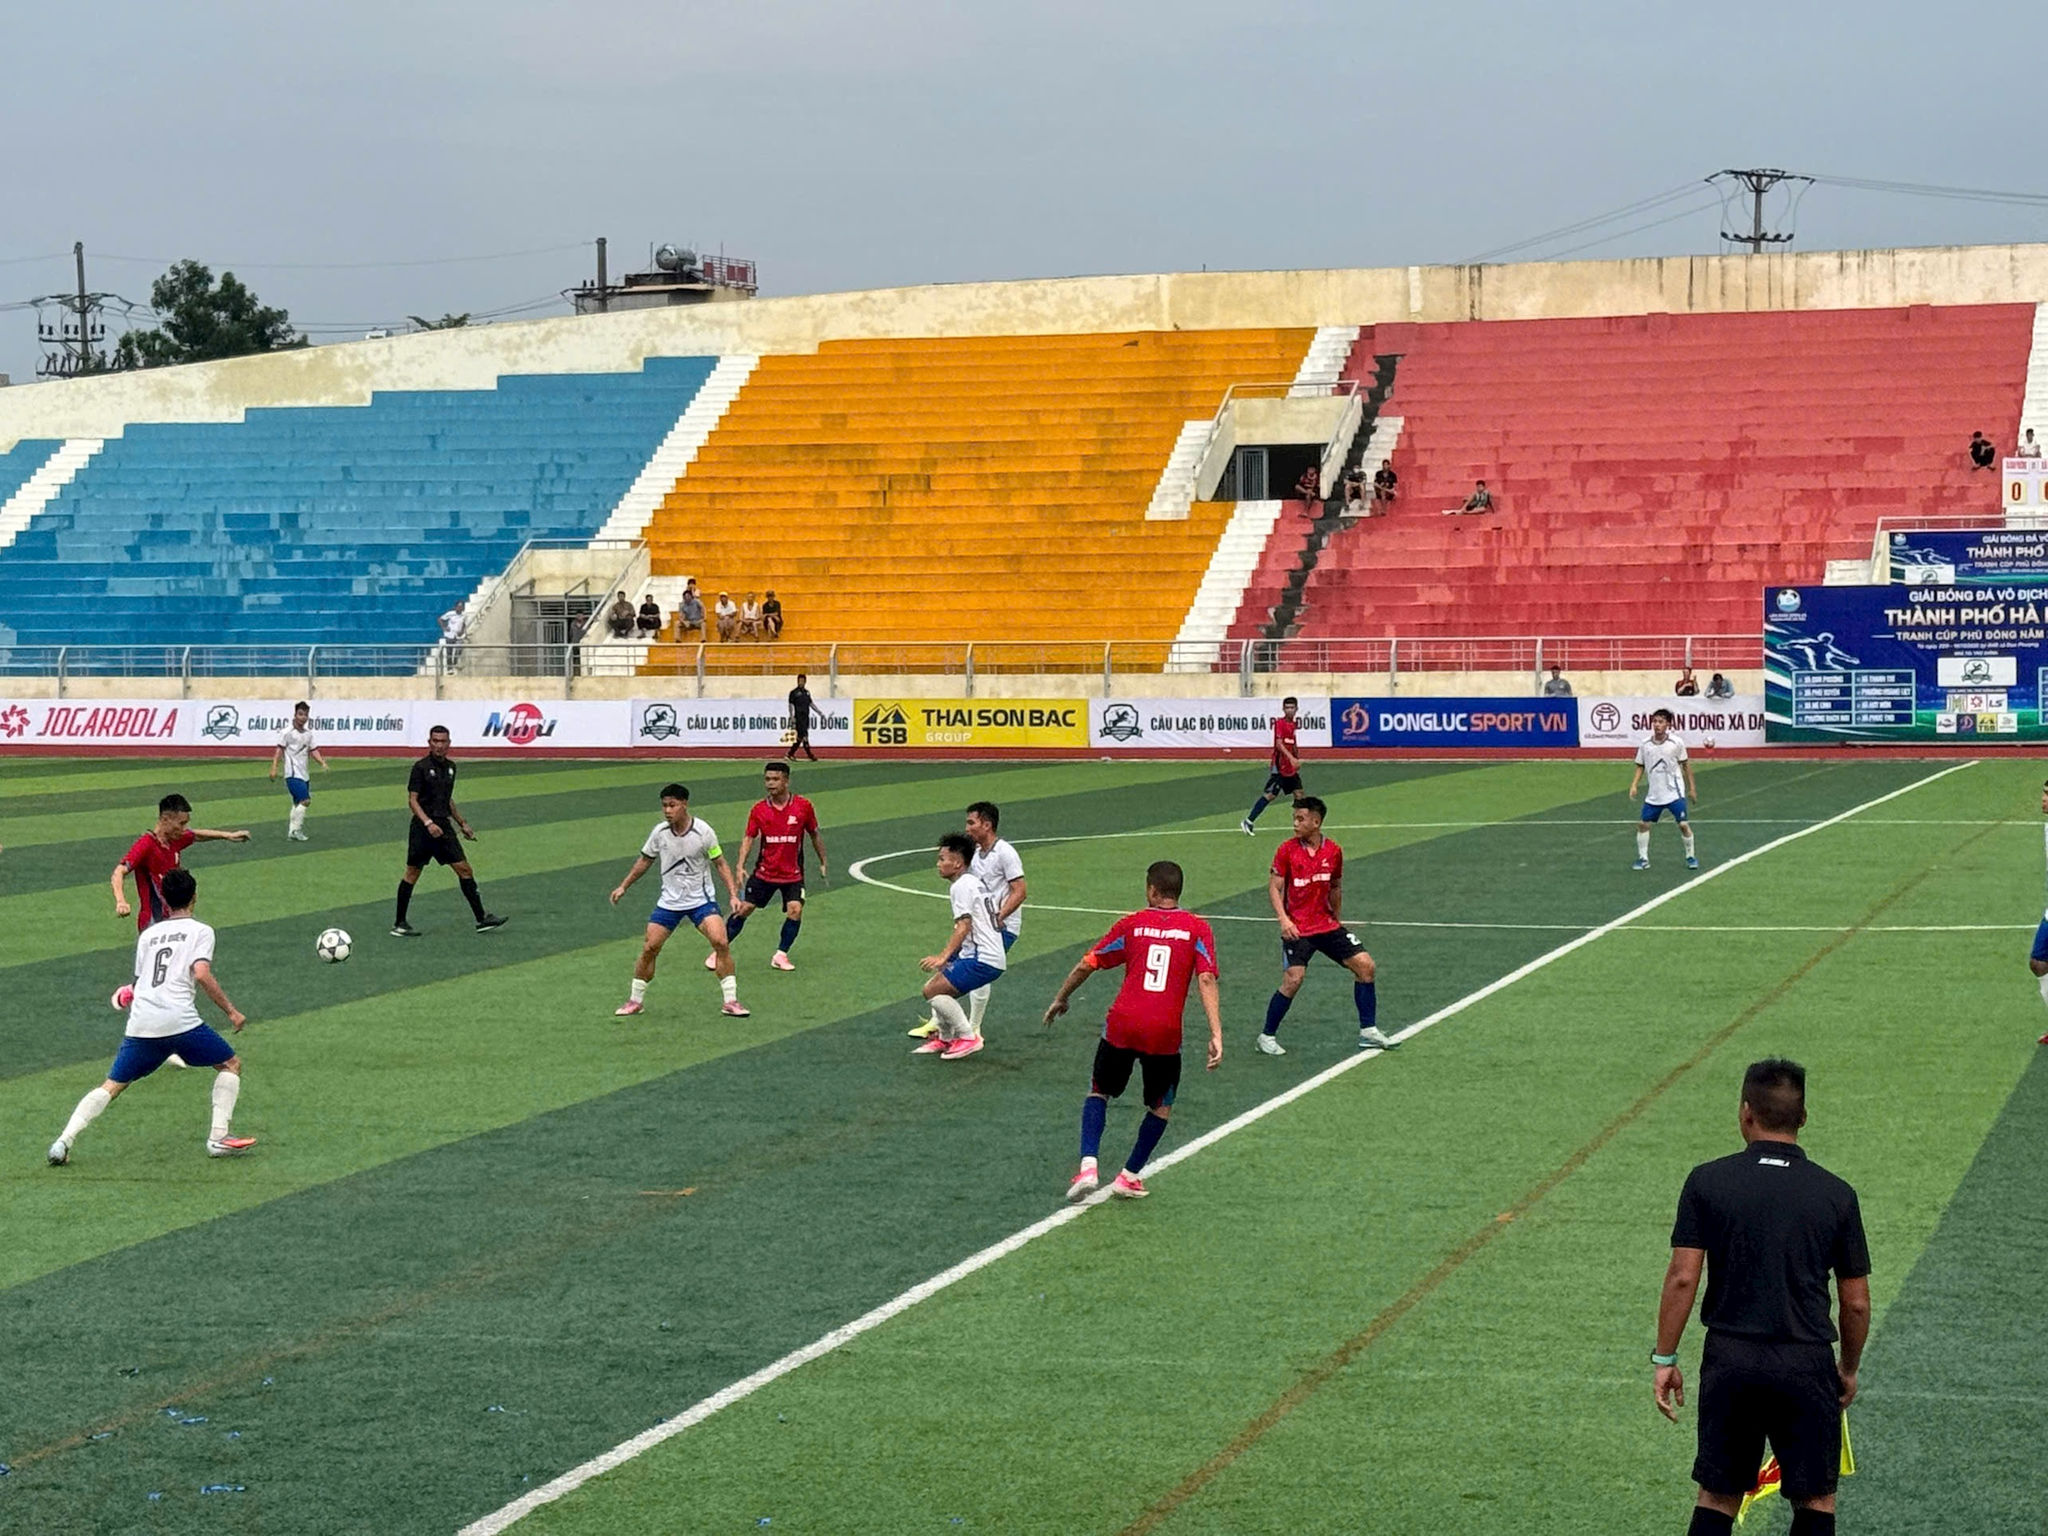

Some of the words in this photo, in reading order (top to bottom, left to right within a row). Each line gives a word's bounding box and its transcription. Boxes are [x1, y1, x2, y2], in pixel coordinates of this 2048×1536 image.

[1966, 545, 2012, 558] THÀNH
[2015, 543, 2045, 558] PHỐ
[1884, 604, 1956, 627] THÀNH
[1961, 603, 2006, 625] PHỐ
[2010, 603, 2040, 625] HÀ
[36, 707, 178, 737] JOGARBOLA
[922, 709, 973, 727] THAI
[977, 709, 1025, 727] SON
[1029, 709, 1076, 727] BAC
[1176, 716, 1196, 734] LẠC
[1380, 713, 1467, 732] DONGLUC
[1470, 713, 1536, 732] SPORT
[1539, 713, 1567, 732] VN
[862, 727, 907, 744] TSB
[926, 733, 972, 743] GROUP
[151, 947, 173, 988] 6
[1143, 944, 1171, 992] 9
